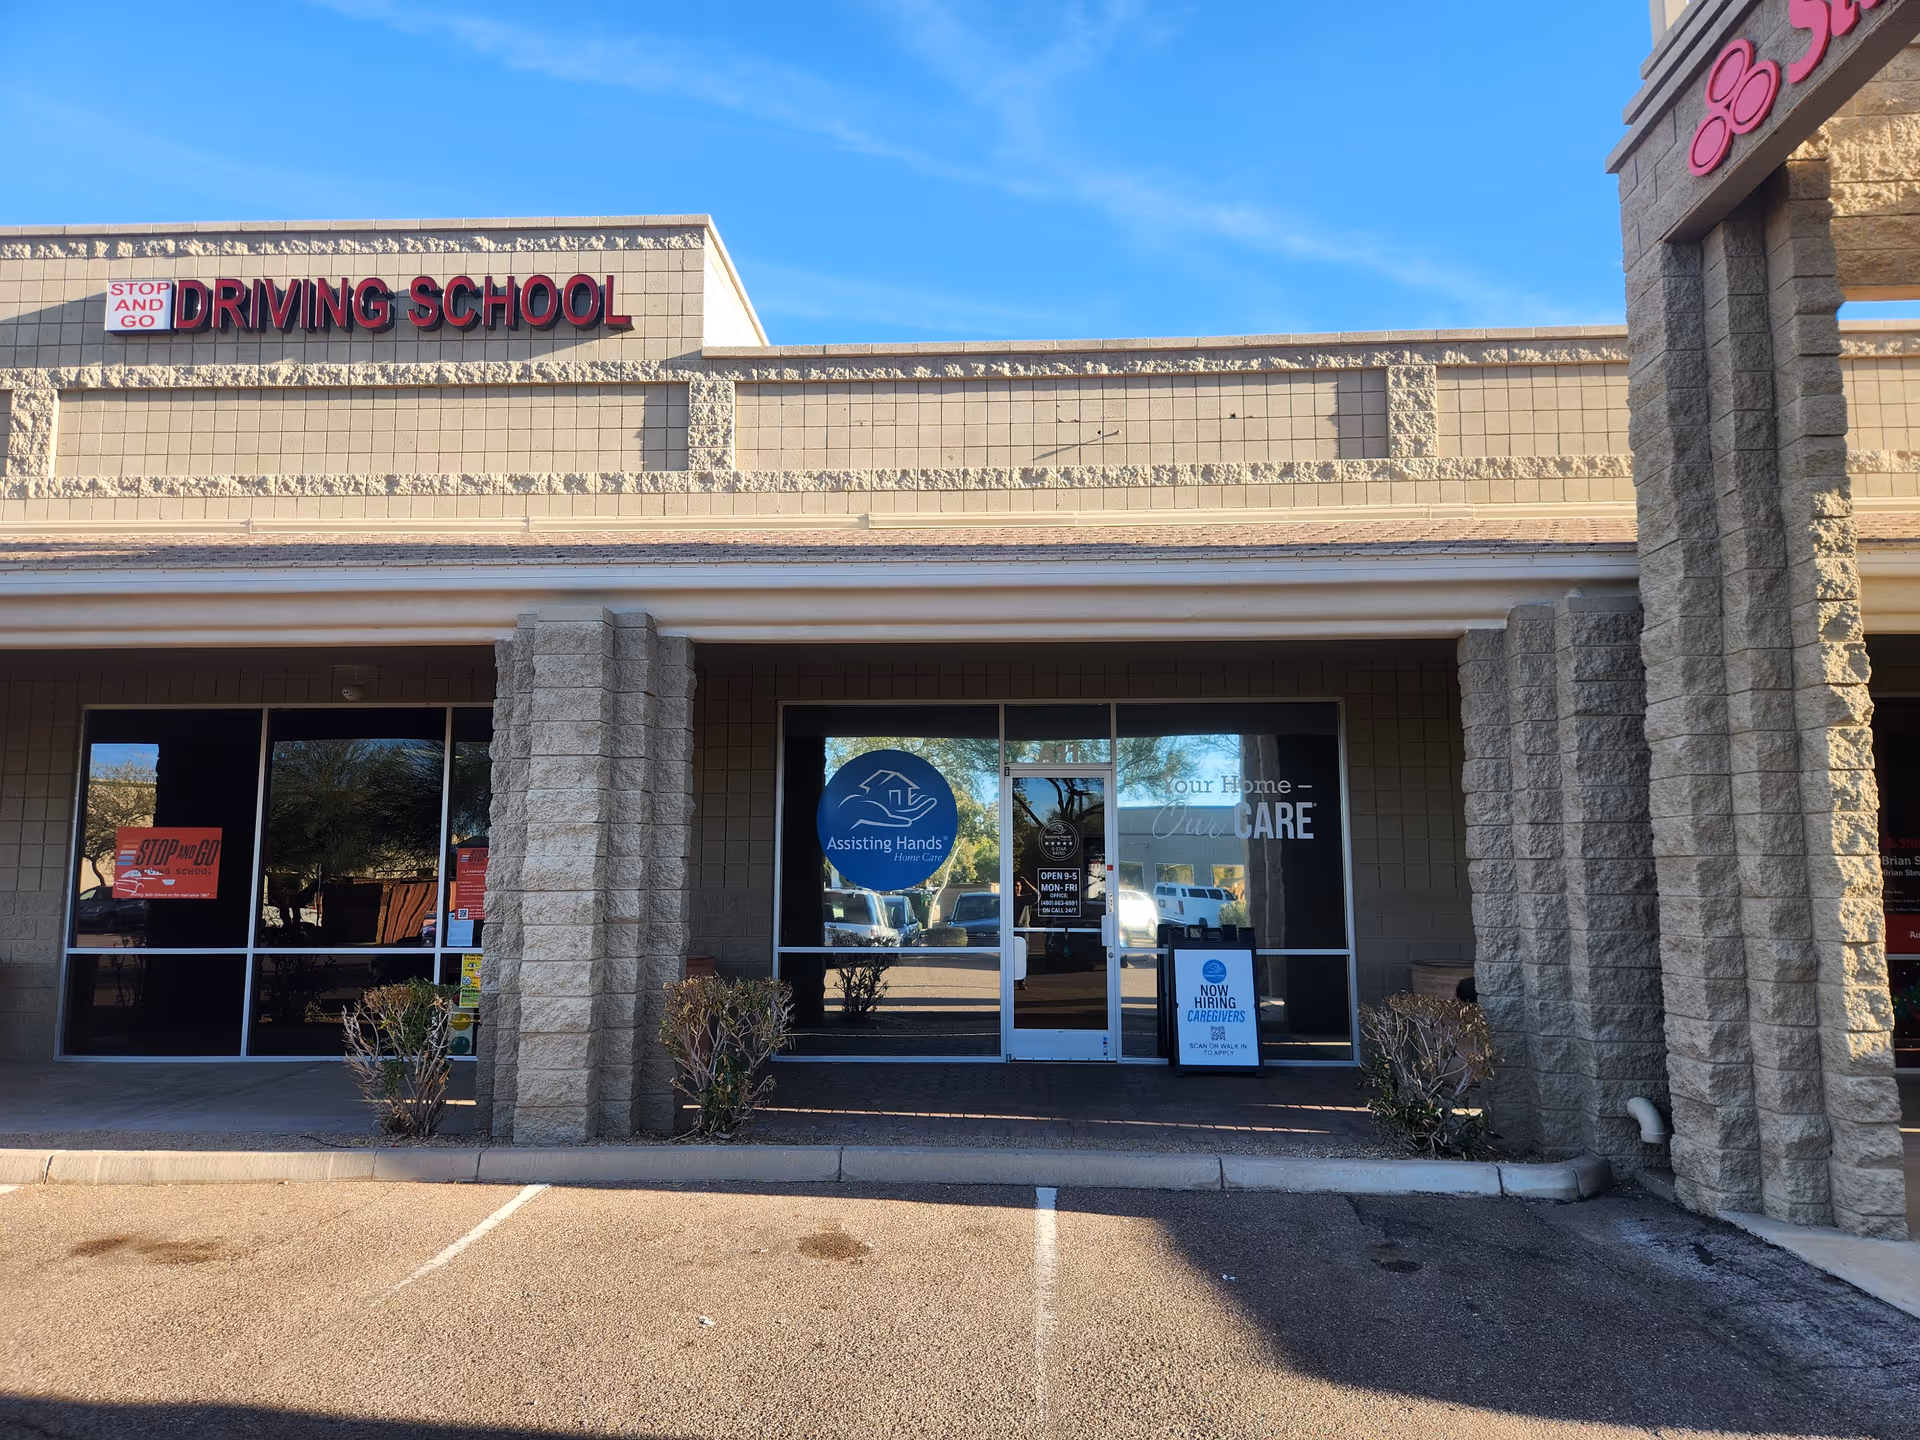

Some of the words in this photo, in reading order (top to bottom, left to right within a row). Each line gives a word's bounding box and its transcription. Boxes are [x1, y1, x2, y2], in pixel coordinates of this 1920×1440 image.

[110, 282, 171, 296] STOP
[114, 298, 164, 312] AND
[173, 277, 391, 329] DRIVING
[407, 273, 632, 328] SCHOOL
[120, 314, 156, 328] GO
[1163, 774, 1214, 794] Your
[1220, 775, 1292, 794] Home
[1152, 800, 1227, 840] Our
[1233, 801, 1314, 840] CARE
[826, 836, 892, 854] Assisting
[896, 836, 943, 851] Hands
[134, 839, 180, 866] STOP
[177, 845, 197, 860] AND
[193, 839, 220, 866] GO
[893, 852, 920, 862] Home
[921, 852, 943, 862] Care
[1881, 855, 1911, 866] Brian
[175, 868, 214, 876] SCHOOL
[1040, 871, 1063, 880] OPEN
[1063, 872, 1078, 880] 9-5
[1883, 869, 1903, 877] Brian
[1064, 883, 1078, 892] FRI
[1200, 984, 1229, 997] NOW
[1194, 996, 1236, 1009] HIRING
[1187, 1009, 1246, 1023] CAREGIVERS
